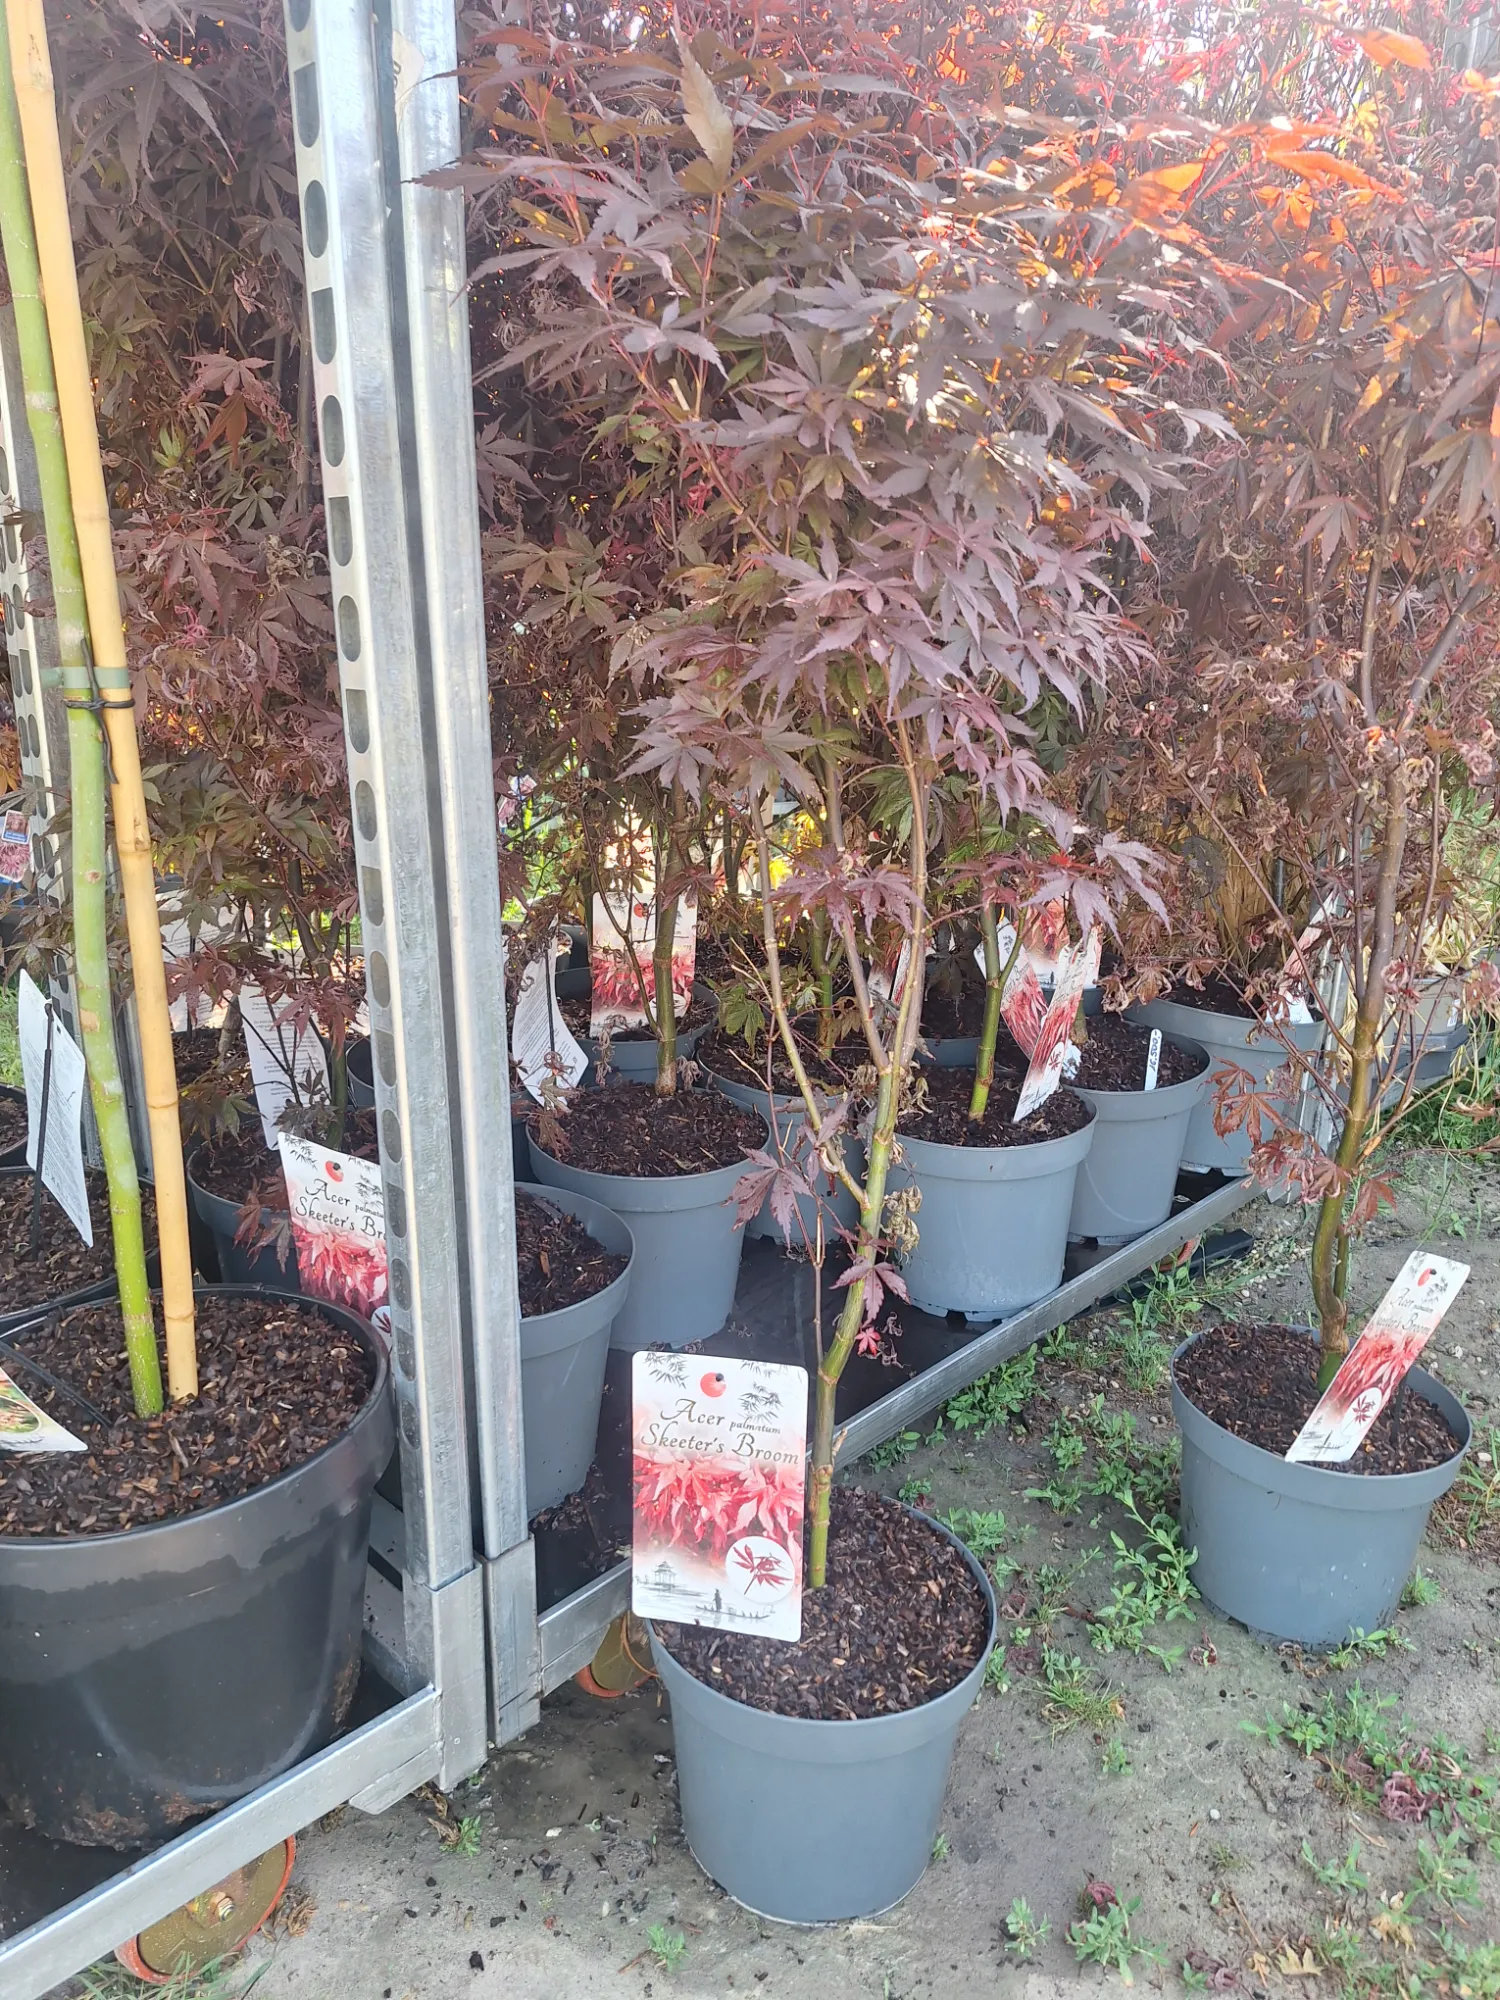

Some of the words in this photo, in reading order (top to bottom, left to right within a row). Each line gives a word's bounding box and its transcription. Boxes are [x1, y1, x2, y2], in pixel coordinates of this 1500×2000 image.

[295, 1196, 355, 1231] Skeeter's
[305, 1178, 350, 1206] Acer
[355, 1202, 384, 1218] palmatu
[660, 1398, 725, 1426] Acer
[729, 1416, 781, 1434] palmatum
[641, 1421, 725, 1454] Skeeter's
[731, 1432, 799, 1465] Broom
